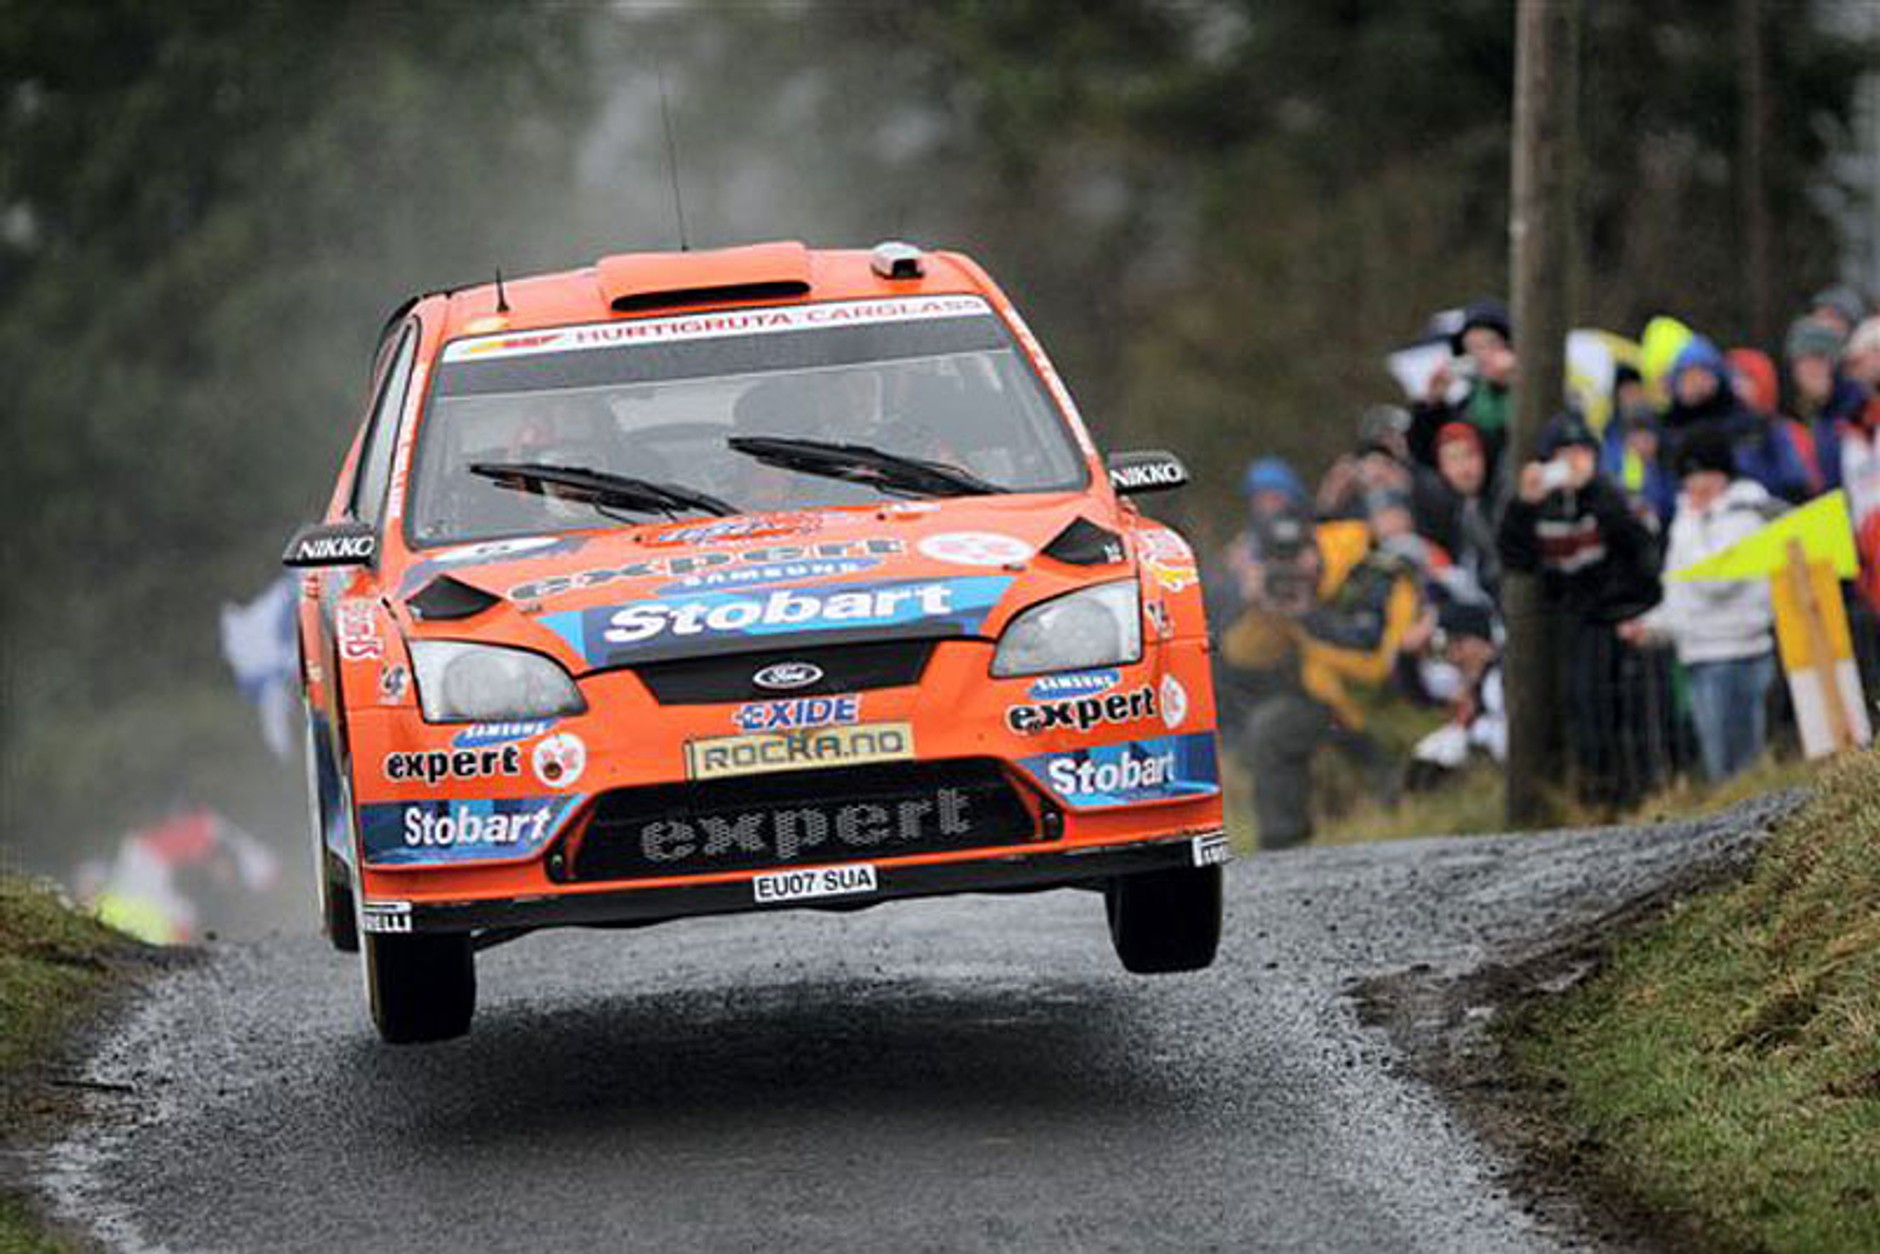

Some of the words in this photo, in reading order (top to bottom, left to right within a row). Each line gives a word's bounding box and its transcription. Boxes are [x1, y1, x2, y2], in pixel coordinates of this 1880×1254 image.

[576, 312, 792, 345] HURTIGRUTA
[806, 298, 983, 326] CARGLASS
[1110, 462, 1183, 487] NIKKO
[297, 535, 375, 559] NIKKO
[508, 539, 904, 600] expert
[683, 562, 861, 586] SAMSUNG
[603, 583, 952, 643] Stobart
[736, 697, 859, 731] EXIDE
[1007, 687, 1156, 731] expert
[385, 745, 521, 786] expert
[1049, 750, 1175, 794] Stobart
[404, 804, 551, 846] Stobart
[640, 787, 973, 862] expert
[757, 873, 817, 899] EU07
[825, 867, 872, 891] SUA
